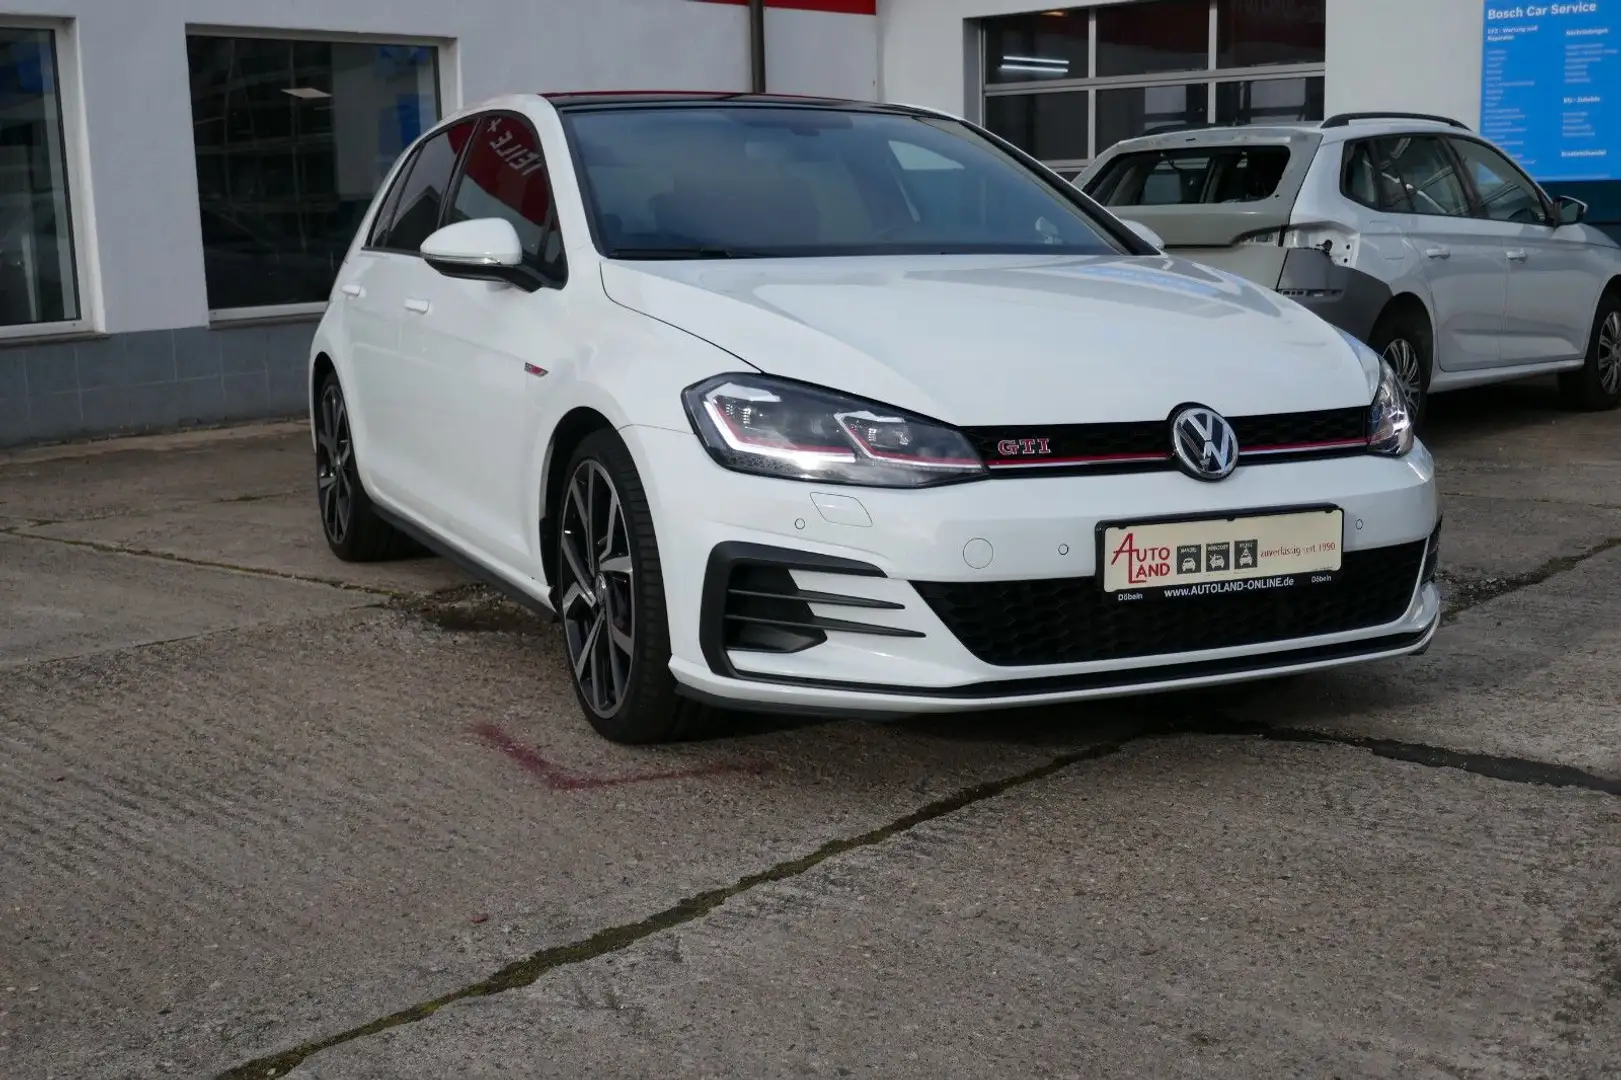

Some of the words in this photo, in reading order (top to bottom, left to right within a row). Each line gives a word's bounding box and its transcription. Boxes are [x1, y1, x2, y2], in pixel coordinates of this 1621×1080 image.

[1488, 6, 1523, 20] Bosch
[1526, 6, 1548, 17] Car
[1551, 2, 1597, 15] Service
[997, 438, 1052, 456] GTI
[1318, 542, 1337, 553] 1990
[1311, 575, 1332, 583] Döbeln
[1164, 577, 1295, 598] www.AUTOLAND-ONLINE.de
[1118, 592, 1143, 601] Döbeln
